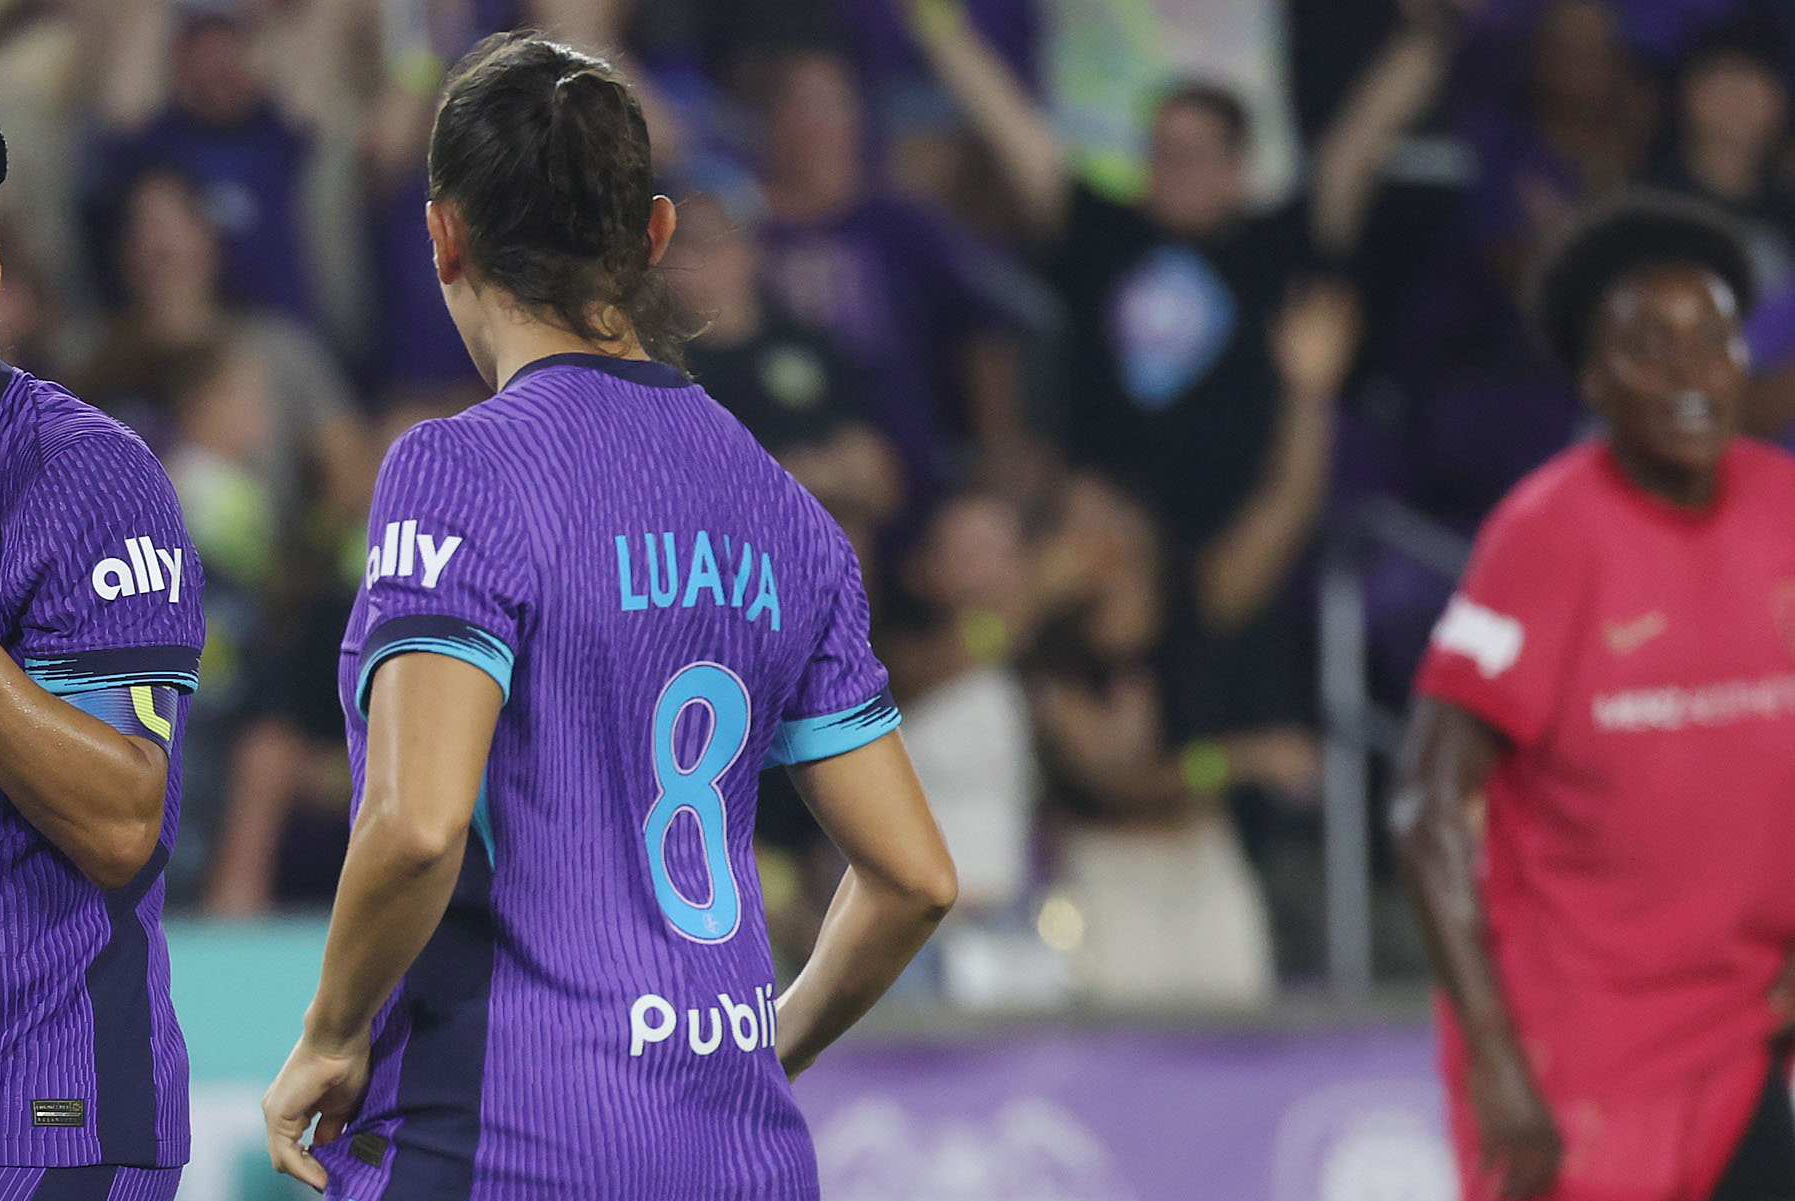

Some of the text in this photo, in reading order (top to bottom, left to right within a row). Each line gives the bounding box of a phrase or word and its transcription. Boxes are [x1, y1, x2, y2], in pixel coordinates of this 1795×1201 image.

[92, 535, 182, 603] ally
[365, 519, 463, 590] ally
[641, 660, 752, 945] 8
